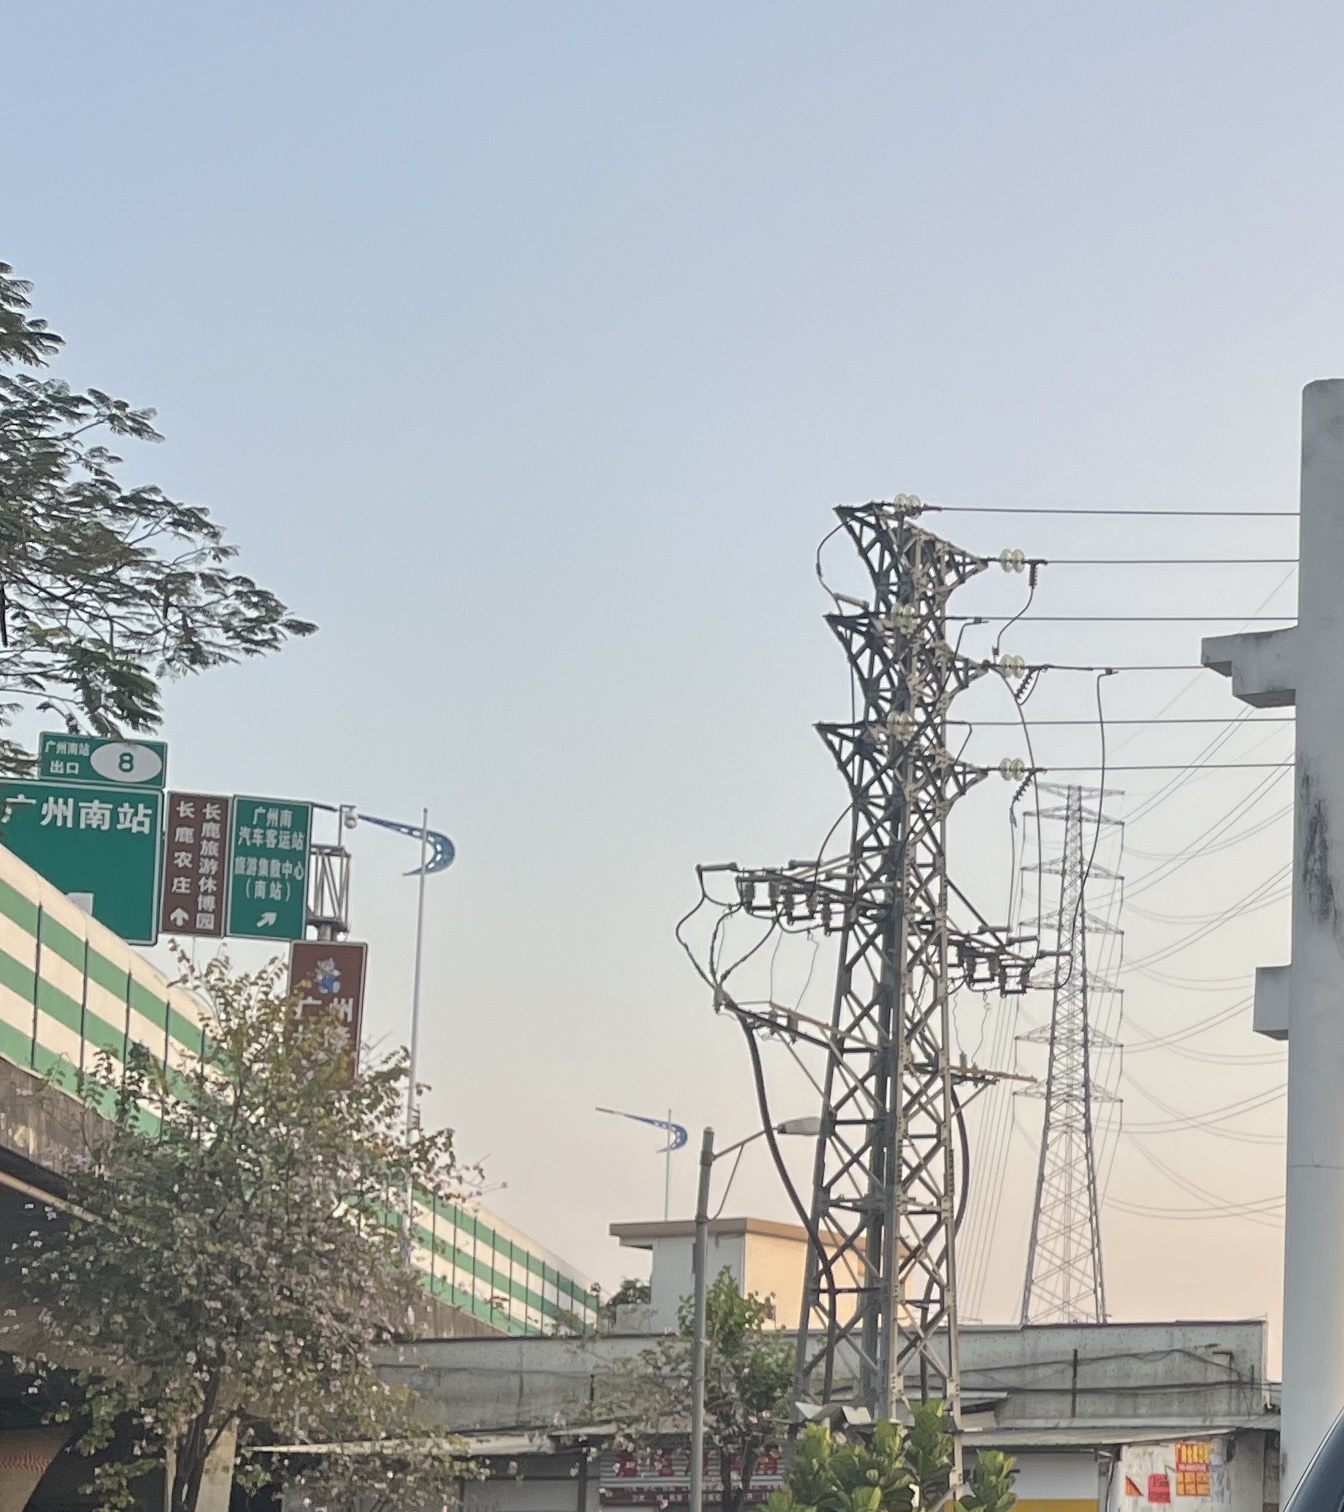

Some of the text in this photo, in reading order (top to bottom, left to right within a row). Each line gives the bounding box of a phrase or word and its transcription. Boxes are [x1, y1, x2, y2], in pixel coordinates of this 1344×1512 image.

[45, 740, 90, 757] 广州南站
[50, 760, 80, 775] 出口
[118, 752, 134, 773] 8
[1, 793, 153, 835] 广州南站
[252, 805, 293, 829] 广州南
[171, 800, 195, 894] 长鹿农庄
[237, 825, 305, 851] 汽车客运站
[234, 855, 305, 881] 旅游集散中心
